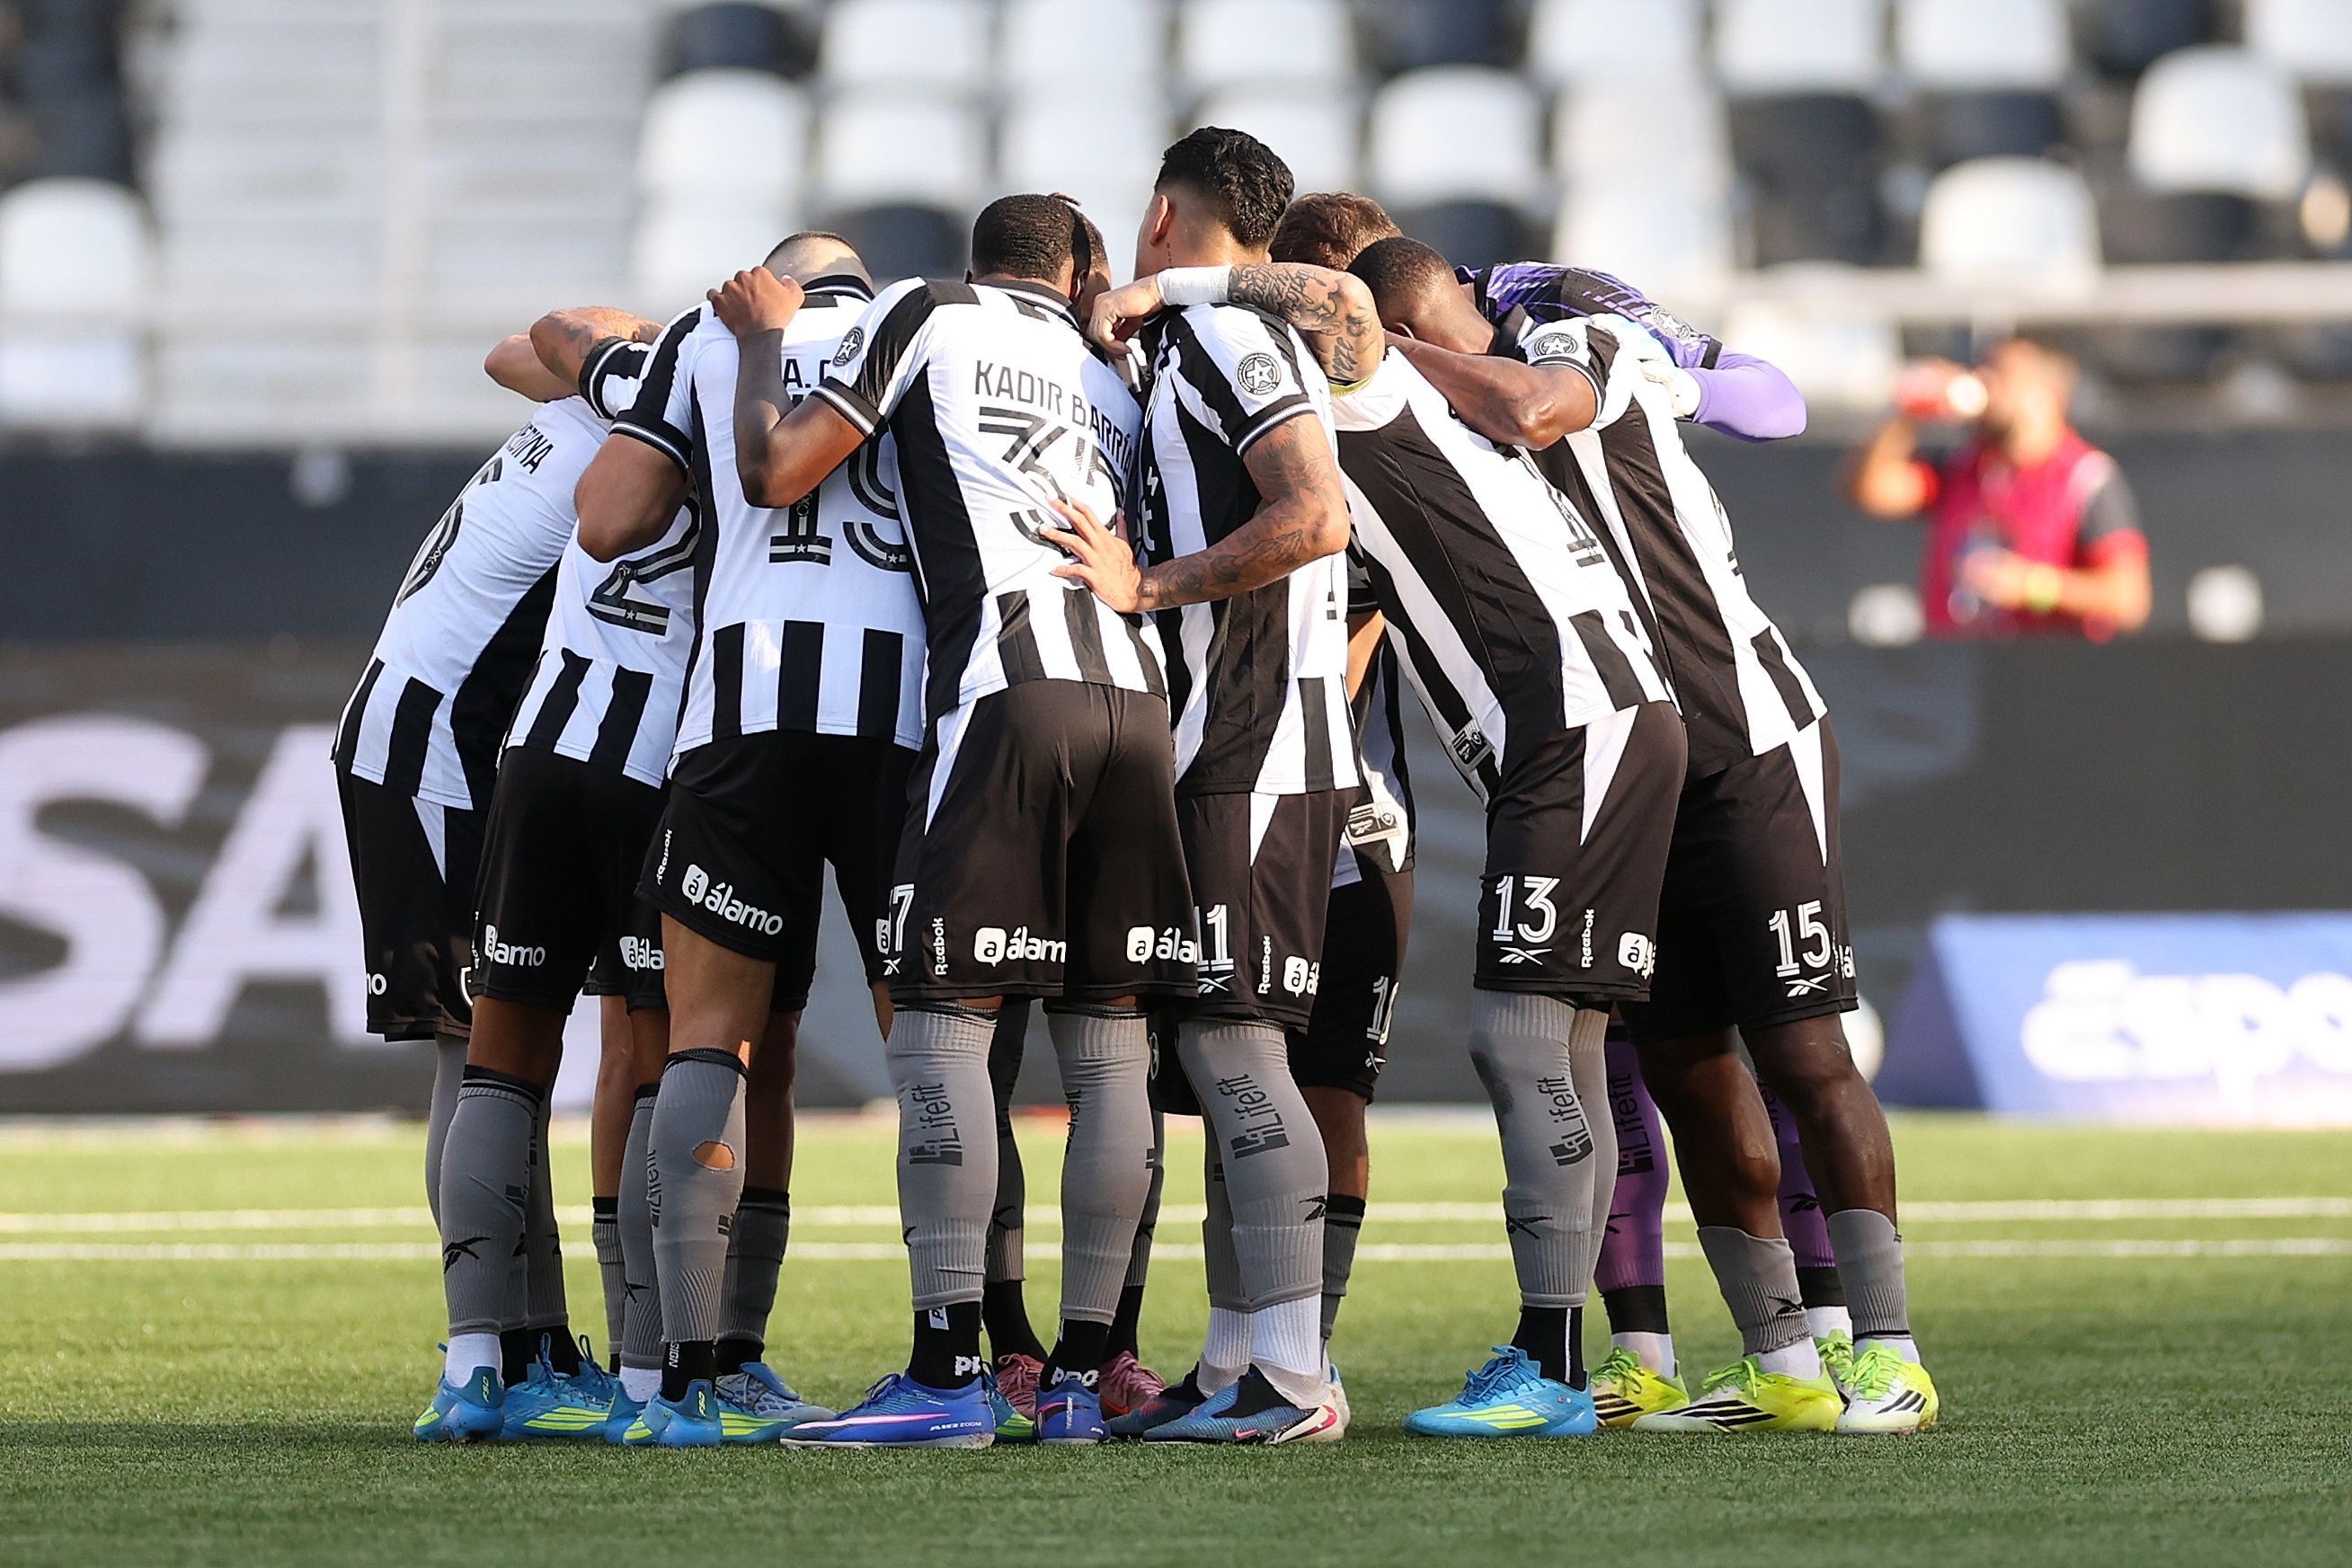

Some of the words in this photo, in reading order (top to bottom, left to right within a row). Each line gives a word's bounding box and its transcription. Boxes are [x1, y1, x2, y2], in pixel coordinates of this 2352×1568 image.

[975, 359, 1062, 415] KADIR
[705, 881, 784, 935] álamo
[1493, 876, 1560, 943] 13
[932, 917, 948, 976] Reebok
[1156, 926, 1198, 964] ála
[1258, 935, 1272, 994] Reebok
[1581, 908, 1594, 968] Reebok
[1768, 899, 1831, 978] 15
[911, 1082, 960, 1143] Lifefit
[1215, 1074, 1285, 1133] Lifefit
